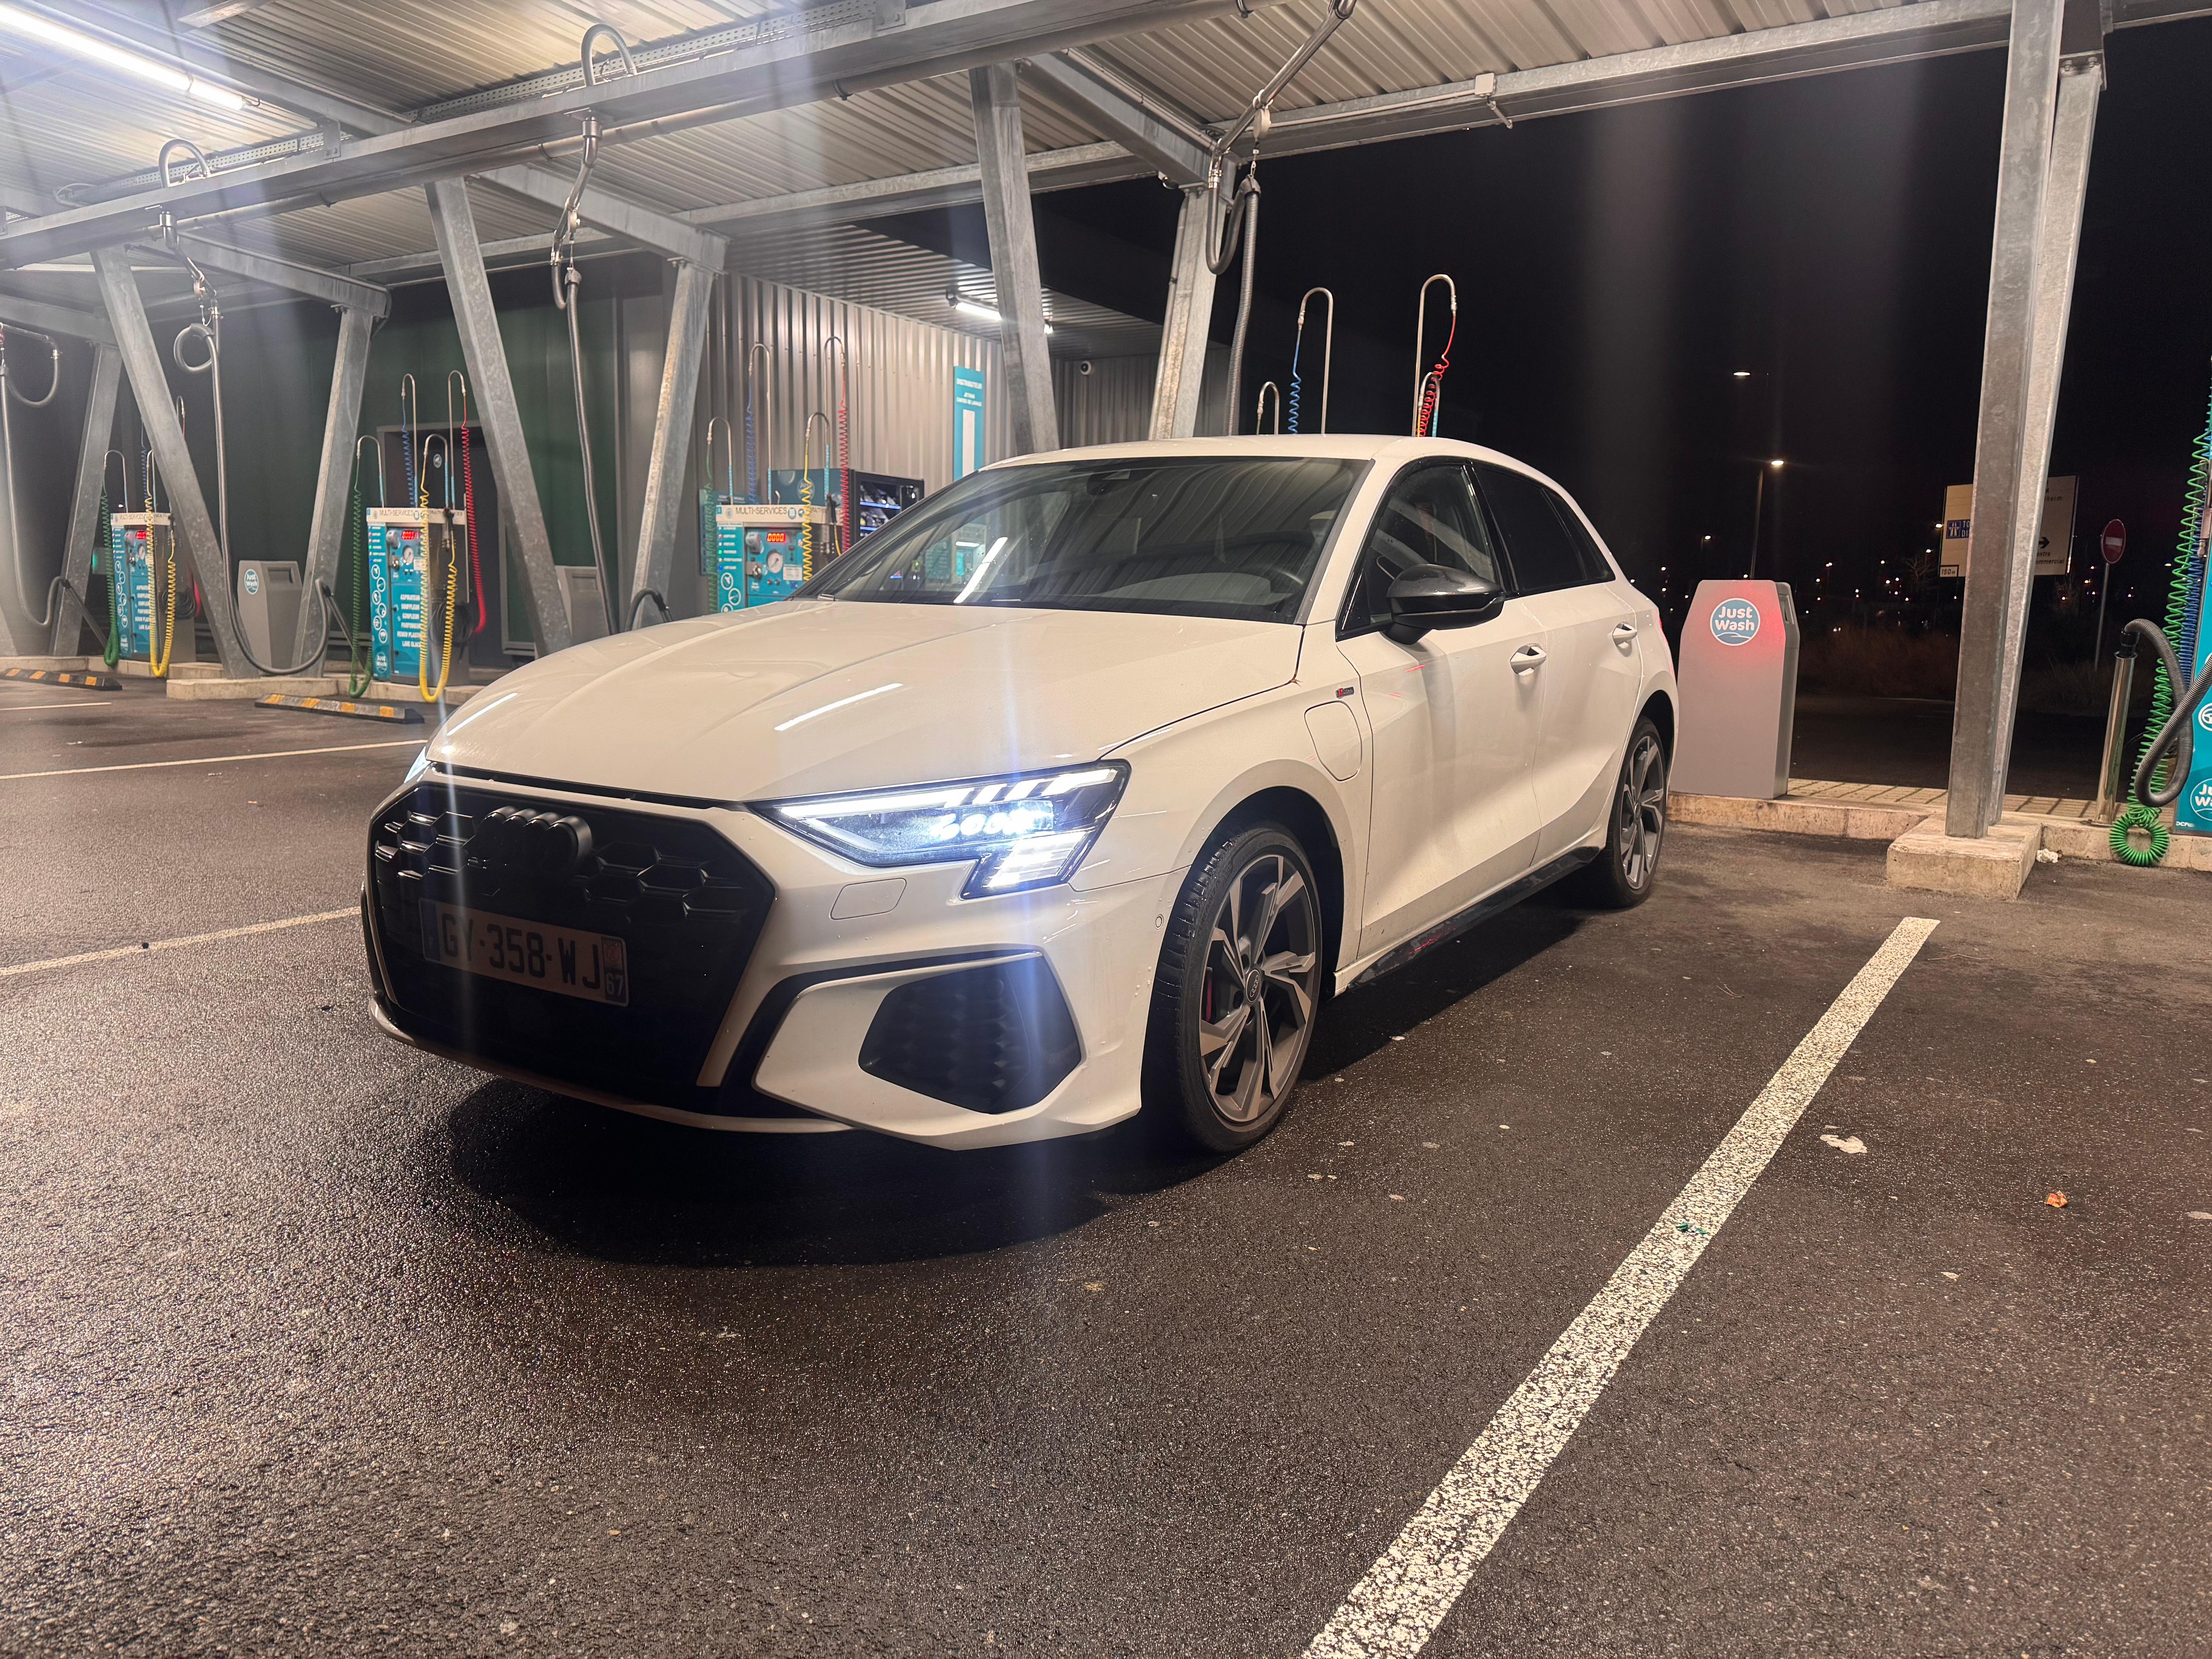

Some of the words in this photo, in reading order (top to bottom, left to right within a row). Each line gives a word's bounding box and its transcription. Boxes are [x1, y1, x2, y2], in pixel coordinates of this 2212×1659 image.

[736, 507, 787, 515] MULTI-SERVICES
[1719, 606, 1752, 618] Just
[1715, 620, 1755, 631] Wash
